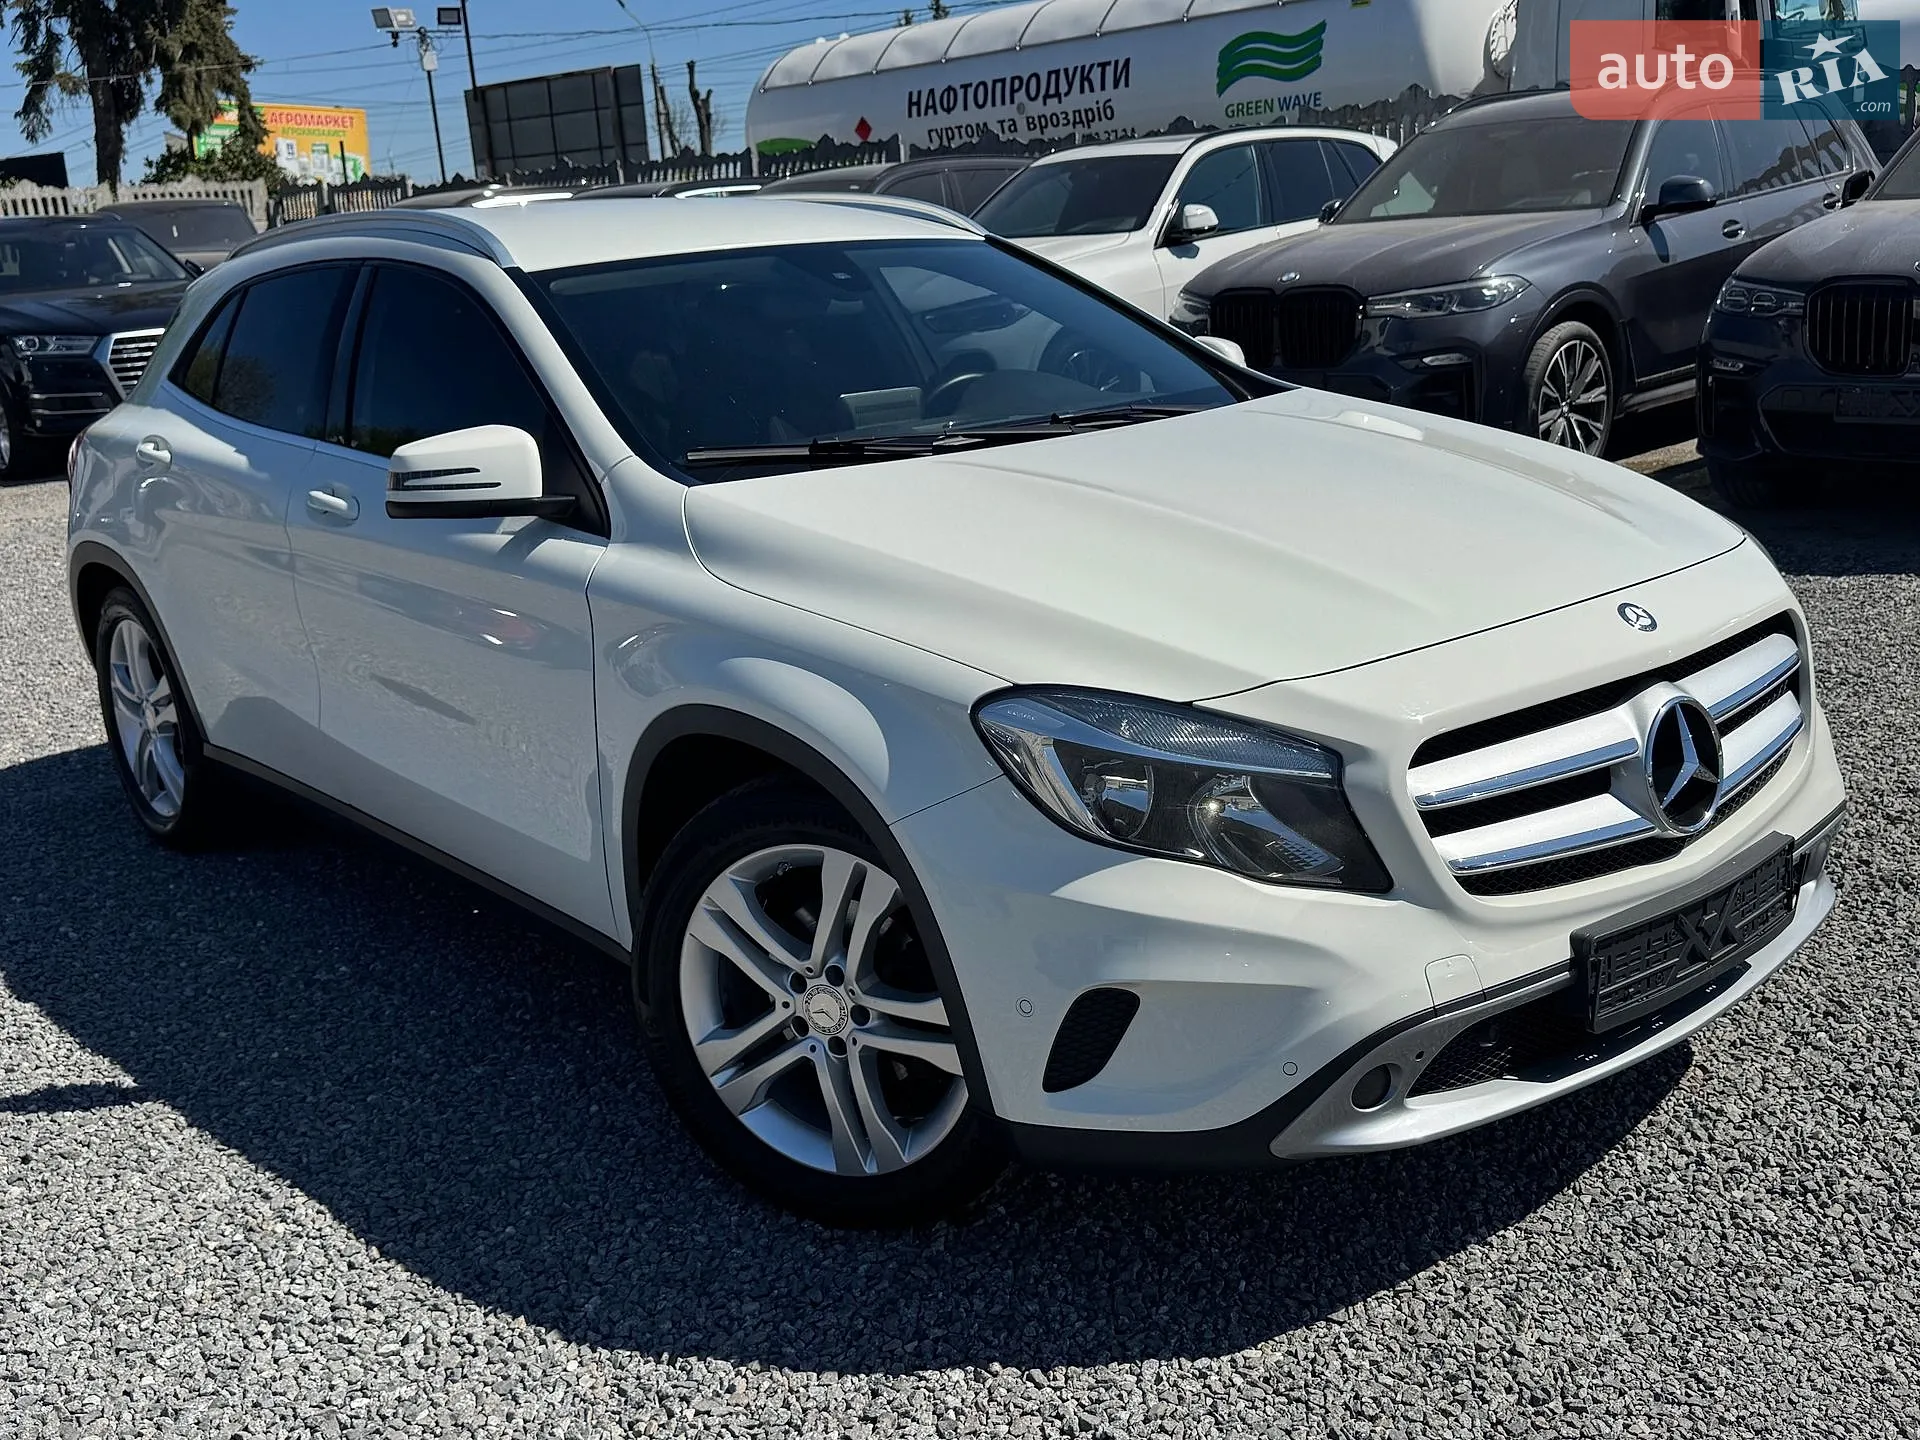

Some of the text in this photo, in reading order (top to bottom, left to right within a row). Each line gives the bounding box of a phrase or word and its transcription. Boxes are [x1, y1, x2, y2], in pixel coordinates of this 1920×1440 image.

[907, 57, 1131, 119] НАФТОПРОДУКТИ
[1224, 91, 1322, 119] GREEN WAVE
[269, 111, 355, 129] АГРОМАРКЕТ
[927, 98, 1115, 146] гуртом та вроздріб
